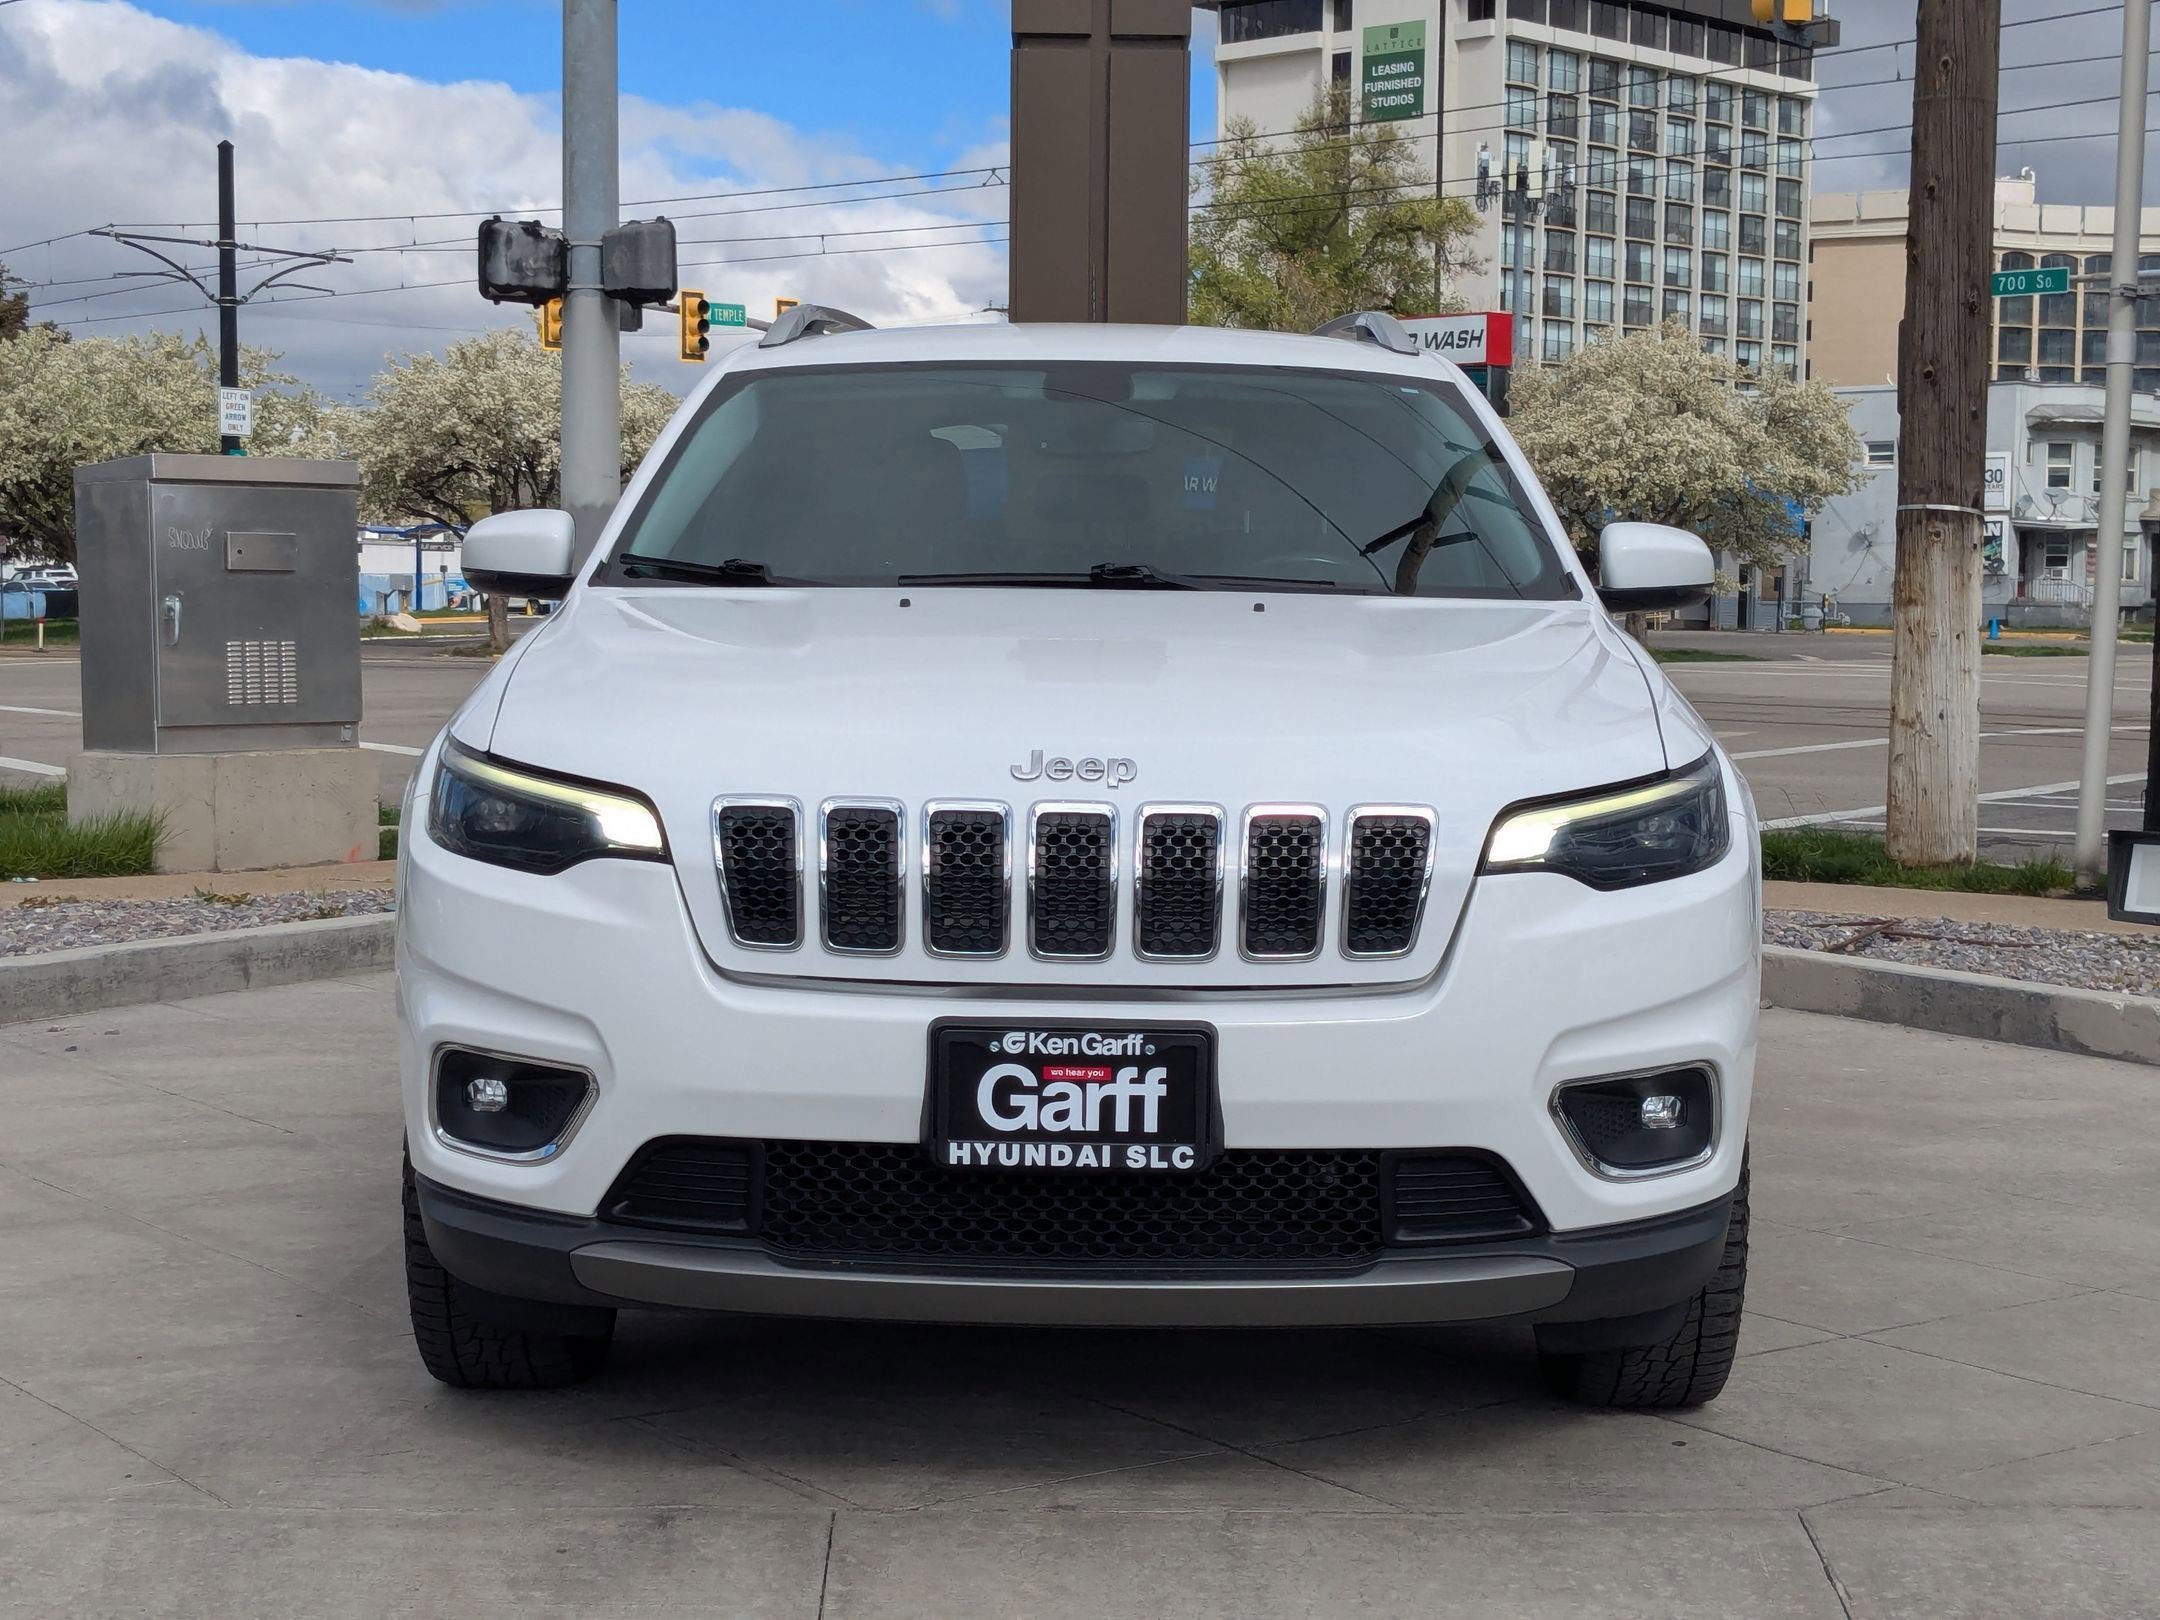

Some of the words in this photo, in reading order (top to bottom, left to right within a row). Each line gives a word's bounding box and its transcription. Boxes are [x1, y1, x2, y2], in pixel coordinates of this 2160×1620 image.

[1366, 38, 1421, 53] LATTICE
[1372, 61, 1415, 76] LEASING
[1364, 77, 1421, 93] FURNISHED
[1371, 93, 1414, 108] STUDIOS
[1998, 276, 2026, 291] 700
[714, 308, 744, 322] TEMPLE
[1424, 329, 1484, 350] WASH
[222, 392, 237, 400] LEFT
[240, 393, 249, 401] ON
[226, 402, 246, 410] GREEN
[225, 413, 247, 421] ARROW
[227, 423, 244, 431] ONLY
[1009, 749, 1138, 790] Jeep
[1065, 1068, 1086, 1077] hear
[1087, 1069, 1104, 1079] you
[976, 1063, 1167, 1133] Garff
[949, 1142, 1111, 1167] HYUNDAI
[1126, 1145, 1194, 1169] SLC
